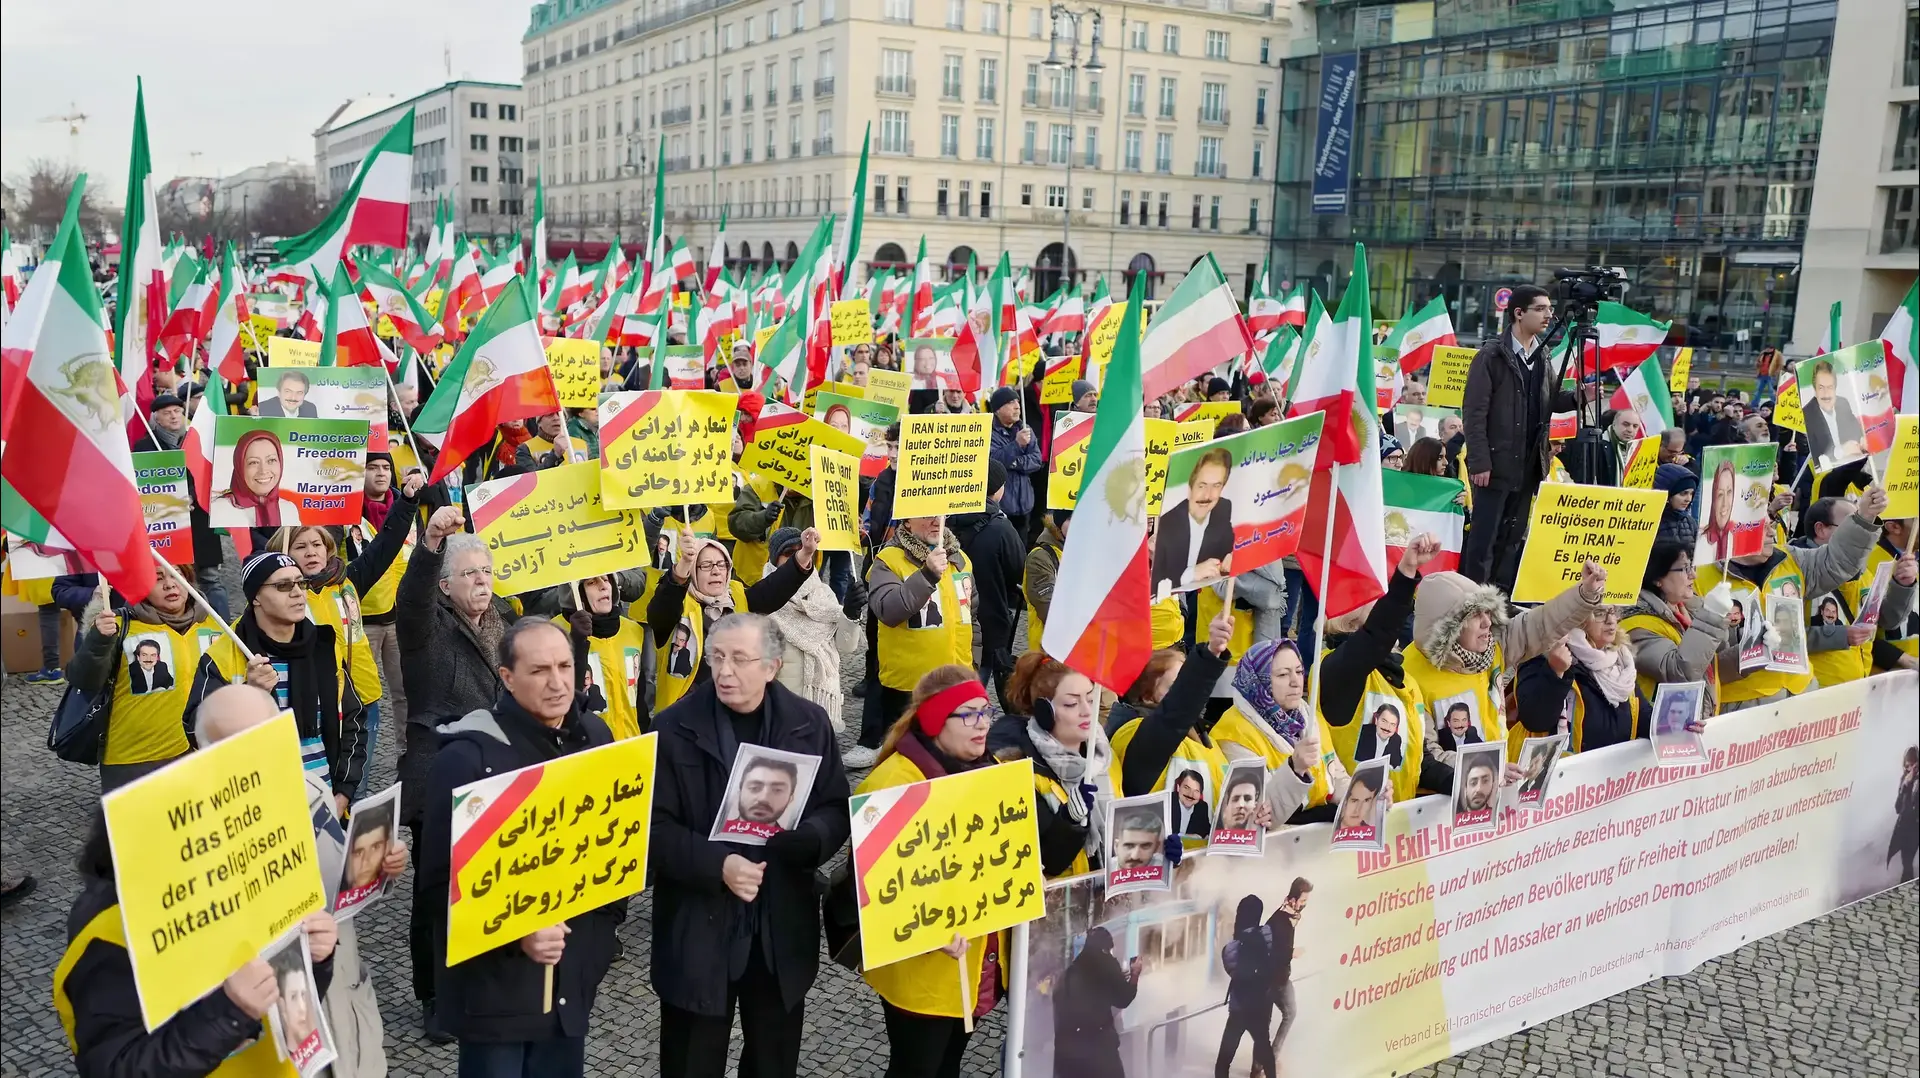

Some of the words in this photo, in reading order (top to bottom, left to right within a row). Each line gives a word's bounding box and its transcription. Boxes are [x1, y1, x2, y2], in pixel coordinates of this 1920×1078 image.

[1316, 126, 1338, 177] Akademie
[1333, 108, 1344, 126] der
[1340, 69, 1357, 108] Künste
[566, 356, 576, 368] هر
[579, 354, 597, 368] شعار
[577, 371, 597, 384] مرگ
[578, 388, 597, 401] مرگ
[632, 414, 682, 441] ایرانی
[686, 419, 700, 438] هر
[703, 415, 728, 438] شعار
[911, 422, 934, 434] IRAN
[937, 422, 948, 434] ist
[950, 424, 967, 433] nun
[968, 422, 982, 432] ein
[1182, 431, 1204, 442] Volk:
[288, 430, 367, 446] Democracy
[777, 428, 814, 447] ایرانی
[905, 439, 931, 450] lauter
[934, 438, 961, 450] Schrei
[964, 437, 984, 448] nach
[1297, 431, 1318, 453] خلق
[297, 447, 357, 459] Freedom
[616, 445, 637, 470] ای
[642, 442, 687, 462] خامنه
[691, 448, 701, 466] بر
[703, 443, 727, 466] مرگ
[776, 444, 806, 462] خامنه
[910, 452, 948, 466] Freiheit!
[950, 453, 977, 464] Dieser
[1240, 450, 1266, 468] بداند
[1268, 442, 1294, 463] جهان
[316, 466, 339, 477] with
[757, 460, 798, 483] روحانی
[821, 456, 835, 474] We
[912, 468, 948, 481] Wunsch
[950, 470, 973, 478] muss
[1062, 458, 1082, 477] ای
[297, 482, 352, 496] Maryam
[628, 472, 690, 498] روحانی
[694, 474, 704, 493] بر
[706, 470, 729, 492] مرگ
[901, 484, 947, 498] anerkannt
[948, 481, 983, 494] werden!
[1900, 482, 1919, 491] IRAN
[302, 498, 345, 511] Rajavi
[567, 492, 588, 510] اصل
[1253, 483, 1292, 508] مسعود
[1556, 494, 1600, 510] Nieder
[1603, 498, 1623, 512] mit
[1626, 500, 1646, 513] der
[510, 504, 530, 520] فقیه
[533, 498, 564, 516] ولایت
[557, 508, 634, 536] زنده
[827, 514, 837, 530] in
[1540, 513, 1604, 529] religiösen
[1608, 516, 1654, 531] Diktatur
[489, 526, 552, 551] باد
[558, 529, 638, 567] ارتش
[1563, 532, 1579, 545] im
[1583, 533, 1616, 547] IRAN
[495, 546, 545, 580] آزادی
[1553, 550, 1569, 562] Es
[1603, 552, 1621, 565] die
[168, 798, 204, 832] Wir
[210, 770, 262, 812] wollen
[599, 774, 644, 816] شعار
[1357, 846, 1391, 875] Die
[1727, 716, 1838, 767] Bundesregierung
[1839, 706, 1862, 735] auf:
[568, 794, 594, 826] هر
[990, 796, 1028, 836] شعار
[1457, 814, 1472, 826] قیام
[1473, 810, 1490, 822] شهید
[180, 830, 222, 862] das
[223, 804, 262, 840] Ende
[498, 796, 566, 849] ایرانی
[596, 818, 641, 848] مرگ
[728, 822, 751, 832] قیام
[963, 813, 984, 844] هر
[896, 812, 956, 858] ایرانی
[1214, 832, 1231, 844] قیام
[1231, 832, 1254, 844] شهید
[1333, 830, 1348, 842] قیام
[1349, 828, 1373, 839] شهید
[1355, 879, 1434, 926] politische
[1440, 868, 1468, 897] und
[1472, 834, 1571, 887] wirtschaftliche
[1572, 812, 1657, 850] Beziehungen
[1659, 802, 1680, 825] zur
[1682, 792, 1732, 818] Diktatur
[1734, 784, 1748, 803] im
[1766, 752, 1838, 788] abzubrechen!
[508, 838, 565, 876] خامنه
[570, 834, 589, 866] بر
[989, 839, 1032, 870] مرگ
[162, 878, 196, 910] der
[206, 825, 288, 888] religiösen
[471, 856, 502, 899] ای
[592, 856, 638, 886] مرگ
[910, 854, 962, 887] خامنه
[970, 853, 984, 882] بر
[1113, 871, 1132, 885] قیام
[1133, 868, 1160, 880] شهید
[1350, 922, 1423, 967] Aufstand
[1426, 918, 1452, 943] der
[1454, 890, 1524, 932] iranischen
[1527, 860, 1615, 906] Bevölkerung
[1617, 855, 1635, 878] für
[1638, 841, 1687, 871] Freiheit
[1692, 832, 1713, 856] und
[1716, 810, 1770, 850] Demokratie
[1772, 804, 1784, 820] zu
[1786, 780, 1854, 818] unterstützen!
[567, 874, 586, 904] بر
[878, 866, 904, 905] ای
[992, 878, 1035, 908] مرگ
[152, 890, 242, 955] Diktatur
[244, 878, 260, 902] im
[263, 842, 308, 888] IRAN!
[338, 888, 359, 908] قیام
[972, 892, 988, 922] بر
[268, 890, 320, 938] #IranProtests
[483, 890, 562, 936] روحانی
[894, 902, 968, 942] روحانی
[1344, 955, 1457, 1012] Unterdrückung
[1460, 938, 1489, 968] und
[1494, 916, 1562, 958] Massaker
[1565, 916, 1582, 935] an
[1585, 890, 1649, 928] wehrlosen
[1652, 860, 1739, 904] Demonstranten
[1739, 832, 1800, 870] verurteilen!
[1385, 1025, 1431, 1054] Verband
[1434, 998, 1506, 1038] Exil-Iranischer
[1508, 974, 1577, 1008] Gesellschaften
[1578, 968, 1588, 983] in
[1590, 948, 1644, 976] Deutschland
[1653, 934, 1698, 954] Anhänger
[1749, 886, 1810, 918] Volksmodjahedin
